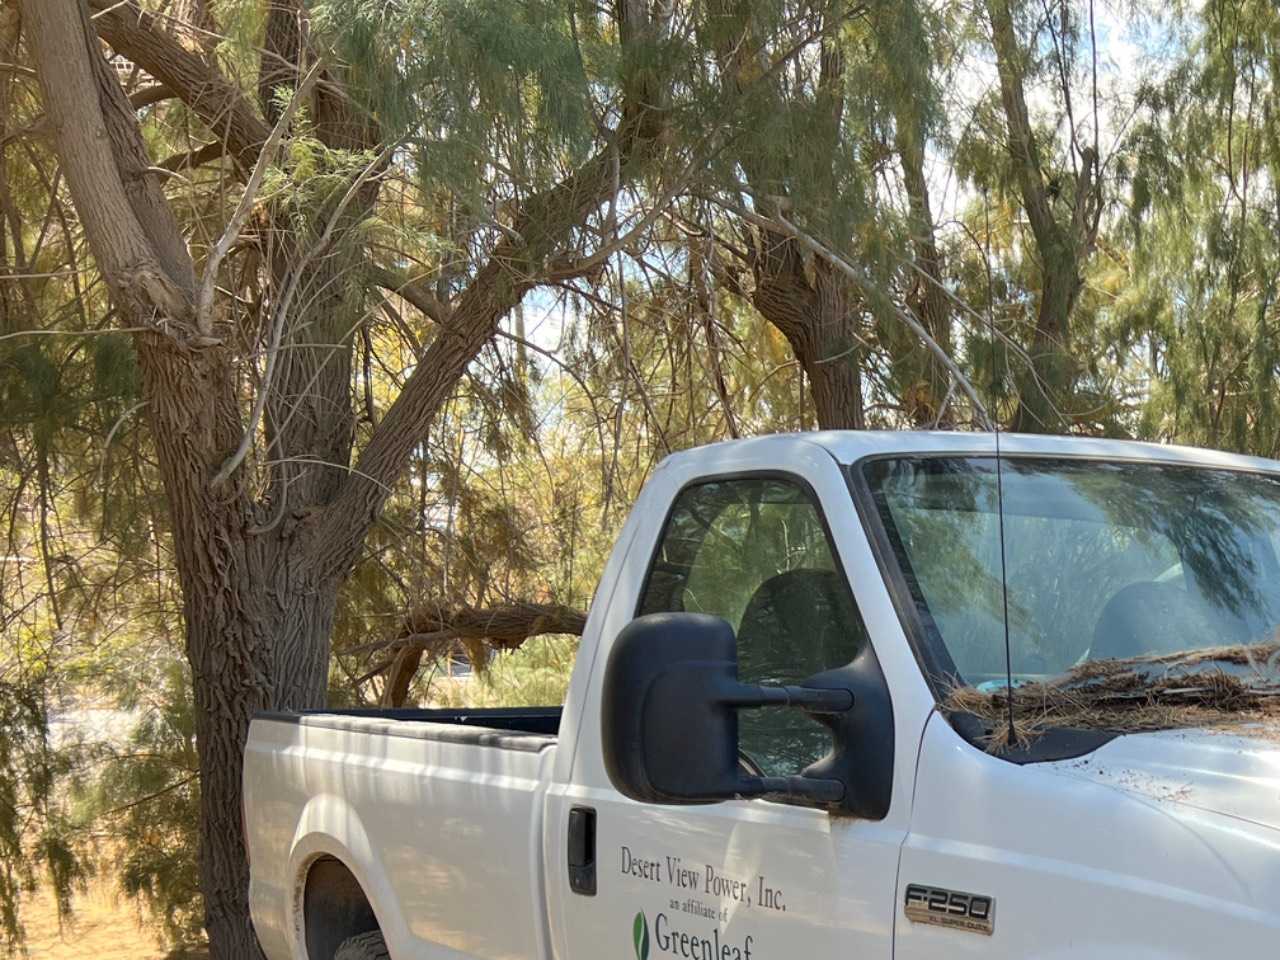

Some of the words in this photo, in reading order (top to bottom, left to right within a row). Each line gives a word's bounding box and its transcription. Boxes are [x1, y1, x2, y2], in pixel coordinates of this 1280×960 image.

[621, 846, 661, 883] Desert
[666, 856, 700, 889] View
[705, 864, 751, 908] Power,
[758, 876, 786, 912] Inc.
[669, 899, 680, 911] an
[682, 898, 716, 920] affiliate
[718, 908, 729, 923] of
